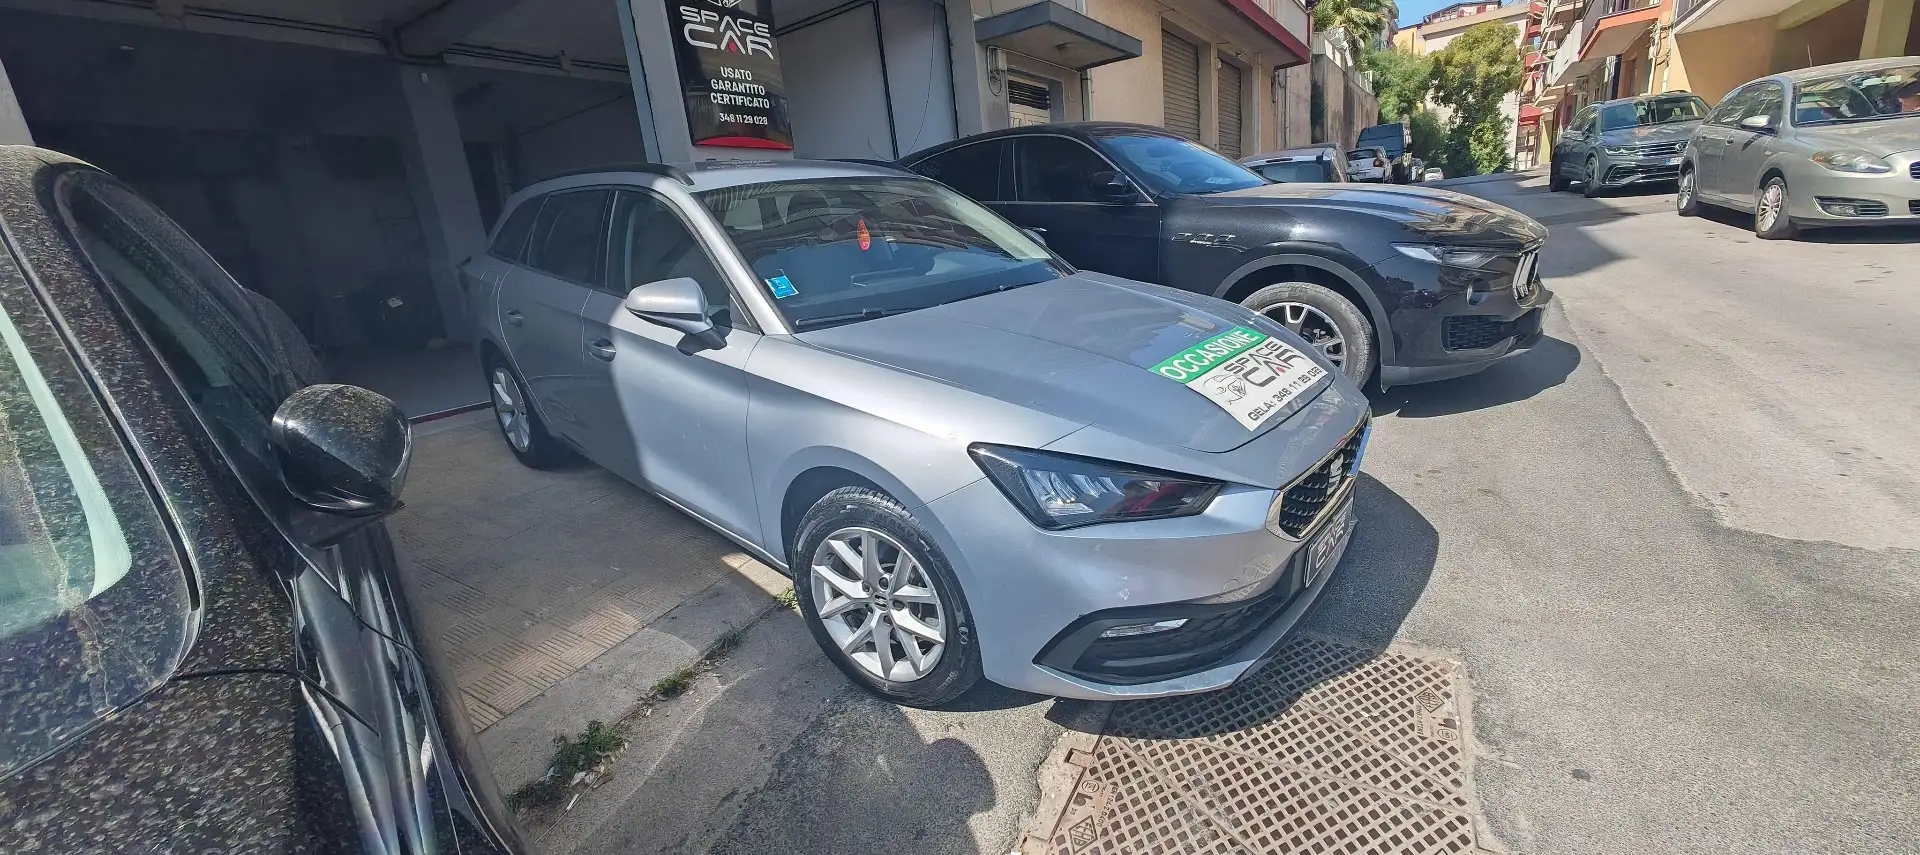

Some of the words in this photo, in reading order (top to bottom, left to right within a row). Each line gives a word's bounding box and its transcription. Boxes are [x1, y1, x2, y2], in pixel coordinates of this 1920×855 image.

[680, 5, 771, 37] SPACE
[684, 23, 774, 60] CAR
[711, 79, 765, 96] GARANTITO
[720, 66, 752, 81] USATO
[710, 92, 770, 109] CERTIFICATO
[719, 113, 736, 123] 348
[736, 114, 743, 123] 11
[1159, 330, 1259, 380] OCCASIONE
[1223, 341, 1283, 375] SPACE
[1241, 349, 1306, 387] CAR
[1247, 400, 1277, 421] GELA:
[1272, 387, 1292, 403] 348
[1288, 381, 1301, 390] 11
